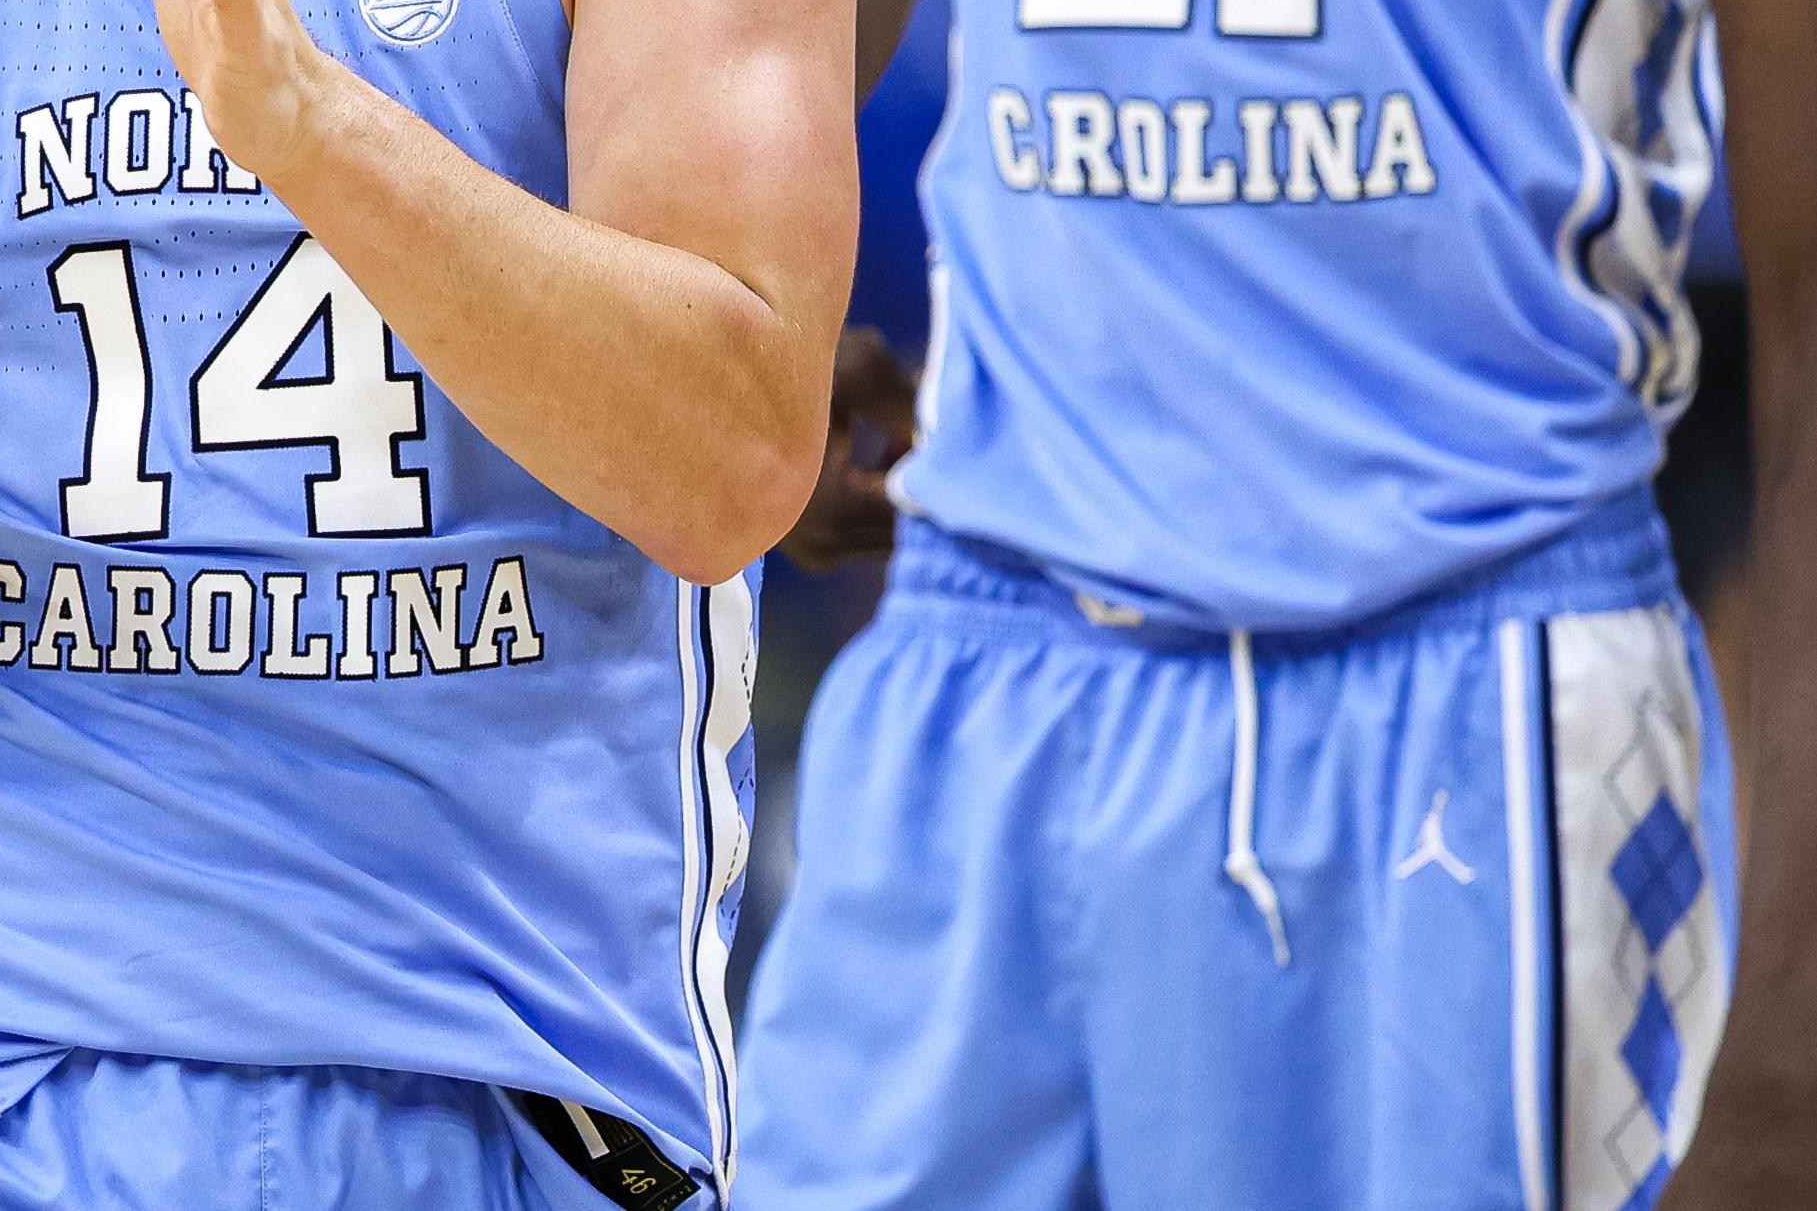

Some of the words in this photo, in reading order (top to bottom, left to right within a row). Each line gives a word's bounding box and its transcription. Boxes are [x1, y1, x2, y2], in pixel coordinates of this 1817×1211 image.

[16, 88, 261, 220] NOR
[988, 85, 1436, 205] CROLINA
[47, 232, 433, 543] 14
[620, 1168, 657, 1194] 46
